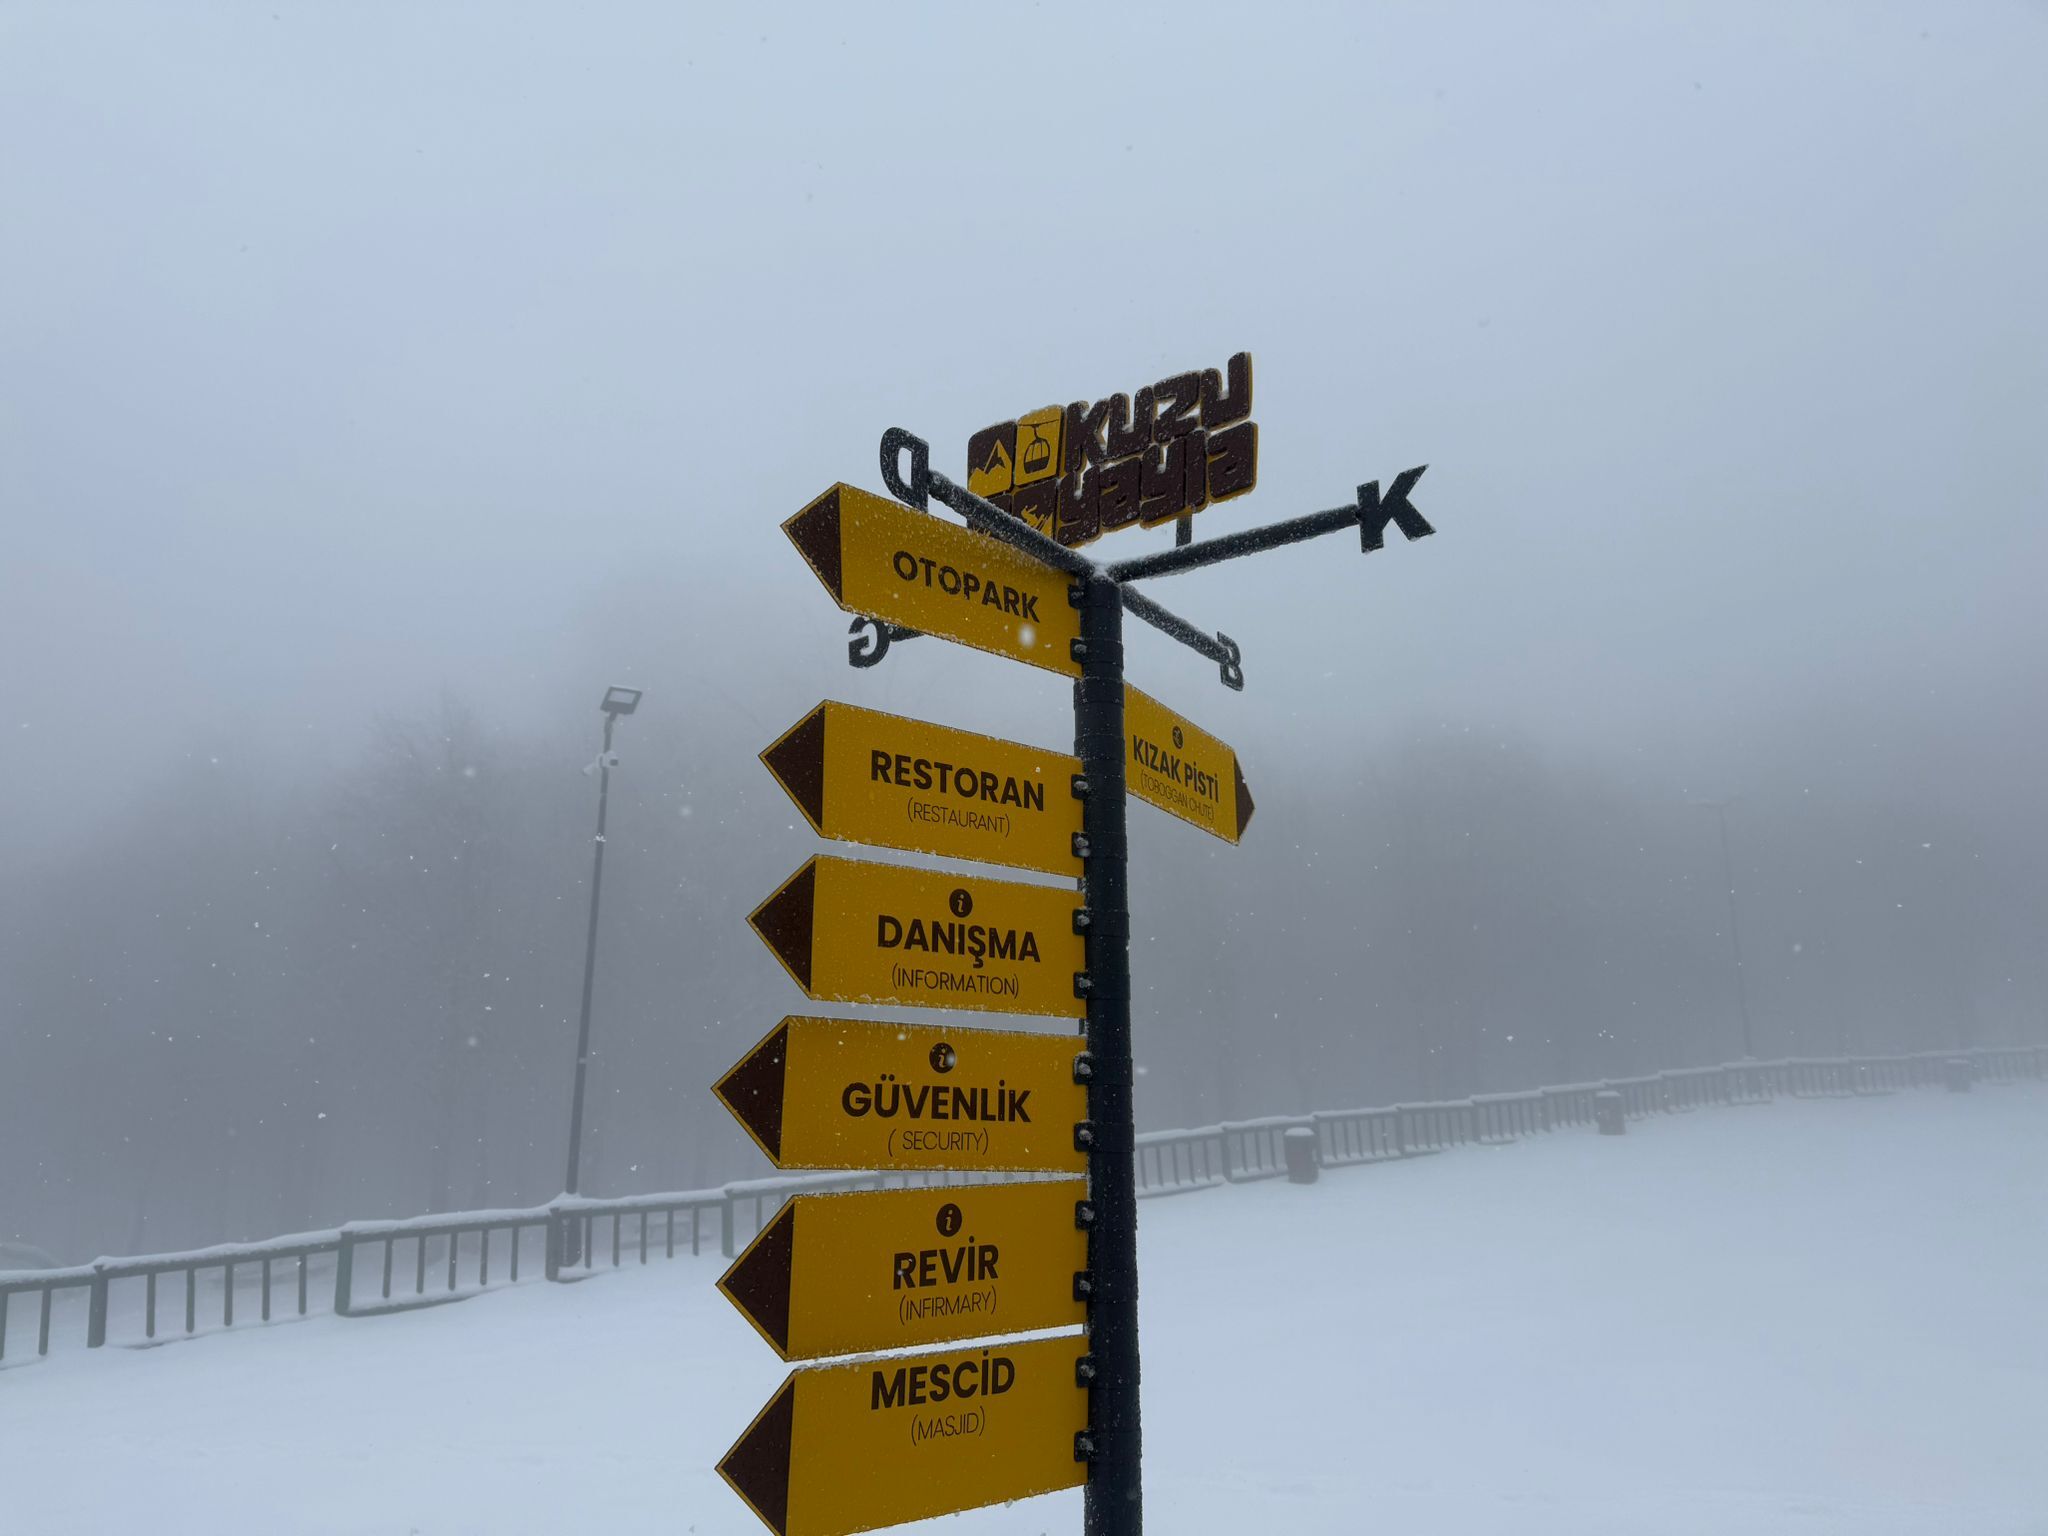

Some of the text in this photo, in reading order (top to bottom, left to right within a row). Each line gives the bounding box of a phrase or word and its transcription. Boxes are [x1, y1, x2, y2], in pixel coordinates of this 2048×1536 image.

[1356, 464, 1436, 553] K
[892, 550, 1040, 624] OTOPARK
[871, 750, 1044, 812] RESTORAN
[1133, 735, 1219, 803] KIZAK PİSTİ
[907, 797, 1010, 838] (RESTAURANT)
[877, 914, 1041, 969] DANIŞMA
[891, 962, 1019, 999] (INFORMATION)
[842, 1073, 1032, 1123] GÜVENLİK
[893, 1235, 999, 1290] REVİR
[899, 1285, 997, 1326] (INFIRMARY)
[871, 1350, 1016, 1410] MESCİD
[911, 1405, 985, 1447] (MASJID)
